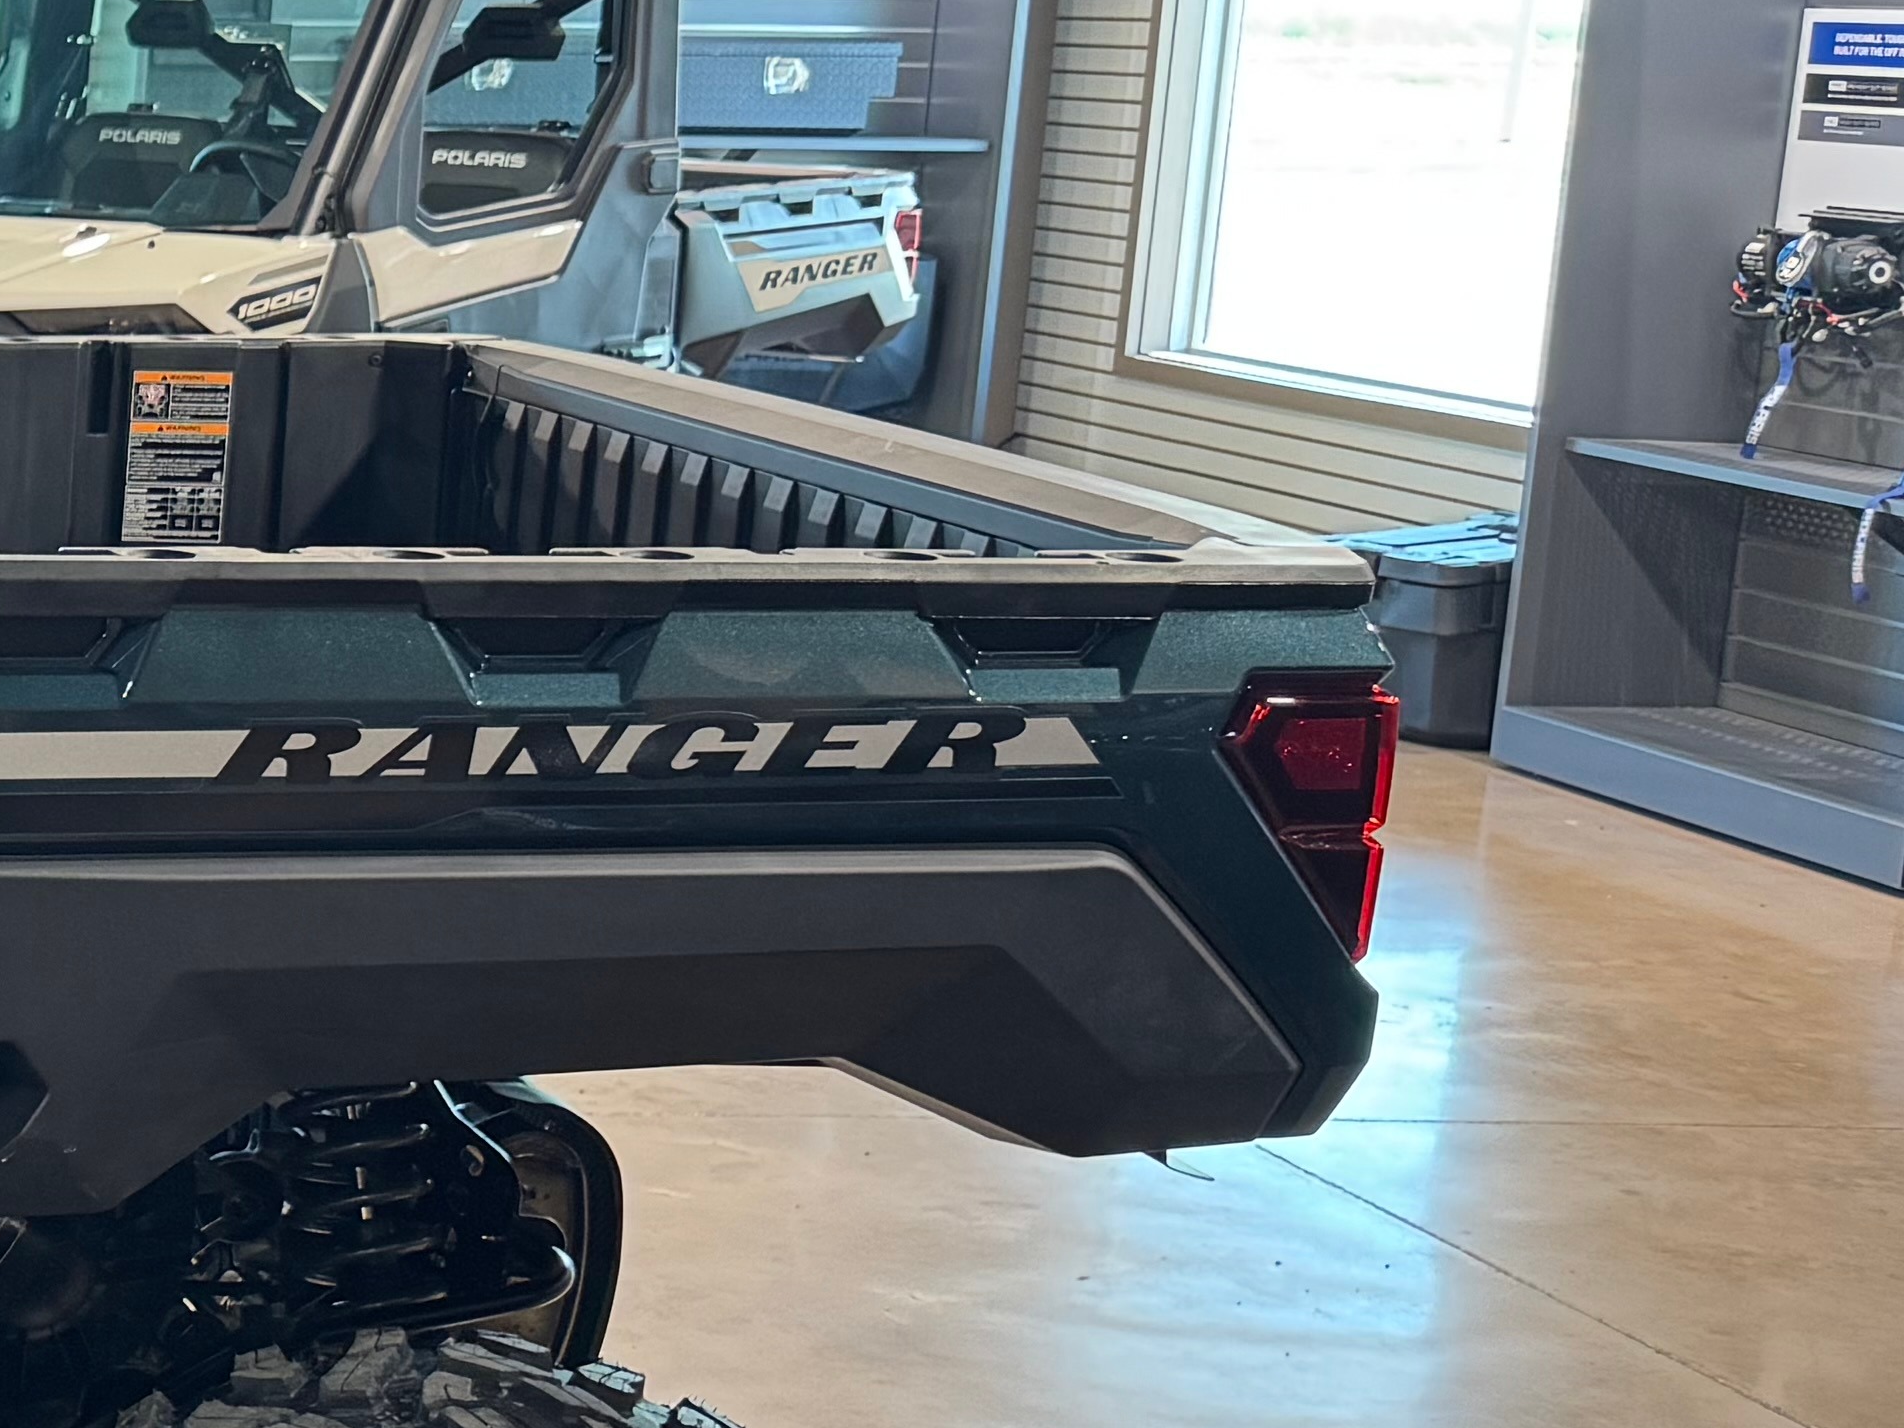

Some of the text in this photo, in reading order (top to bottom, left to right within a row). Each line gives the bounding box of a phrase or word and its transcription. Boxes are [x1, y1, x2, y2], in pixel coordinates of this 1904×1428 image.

[98, 128, 181, 145] POLARIS
[432, 148, 528, 169] POLARIS
[759, 251, 878, 291] RANGER
[237, 283, 317, 320] 1000
[212, 710, 1029, 780] RANGER
